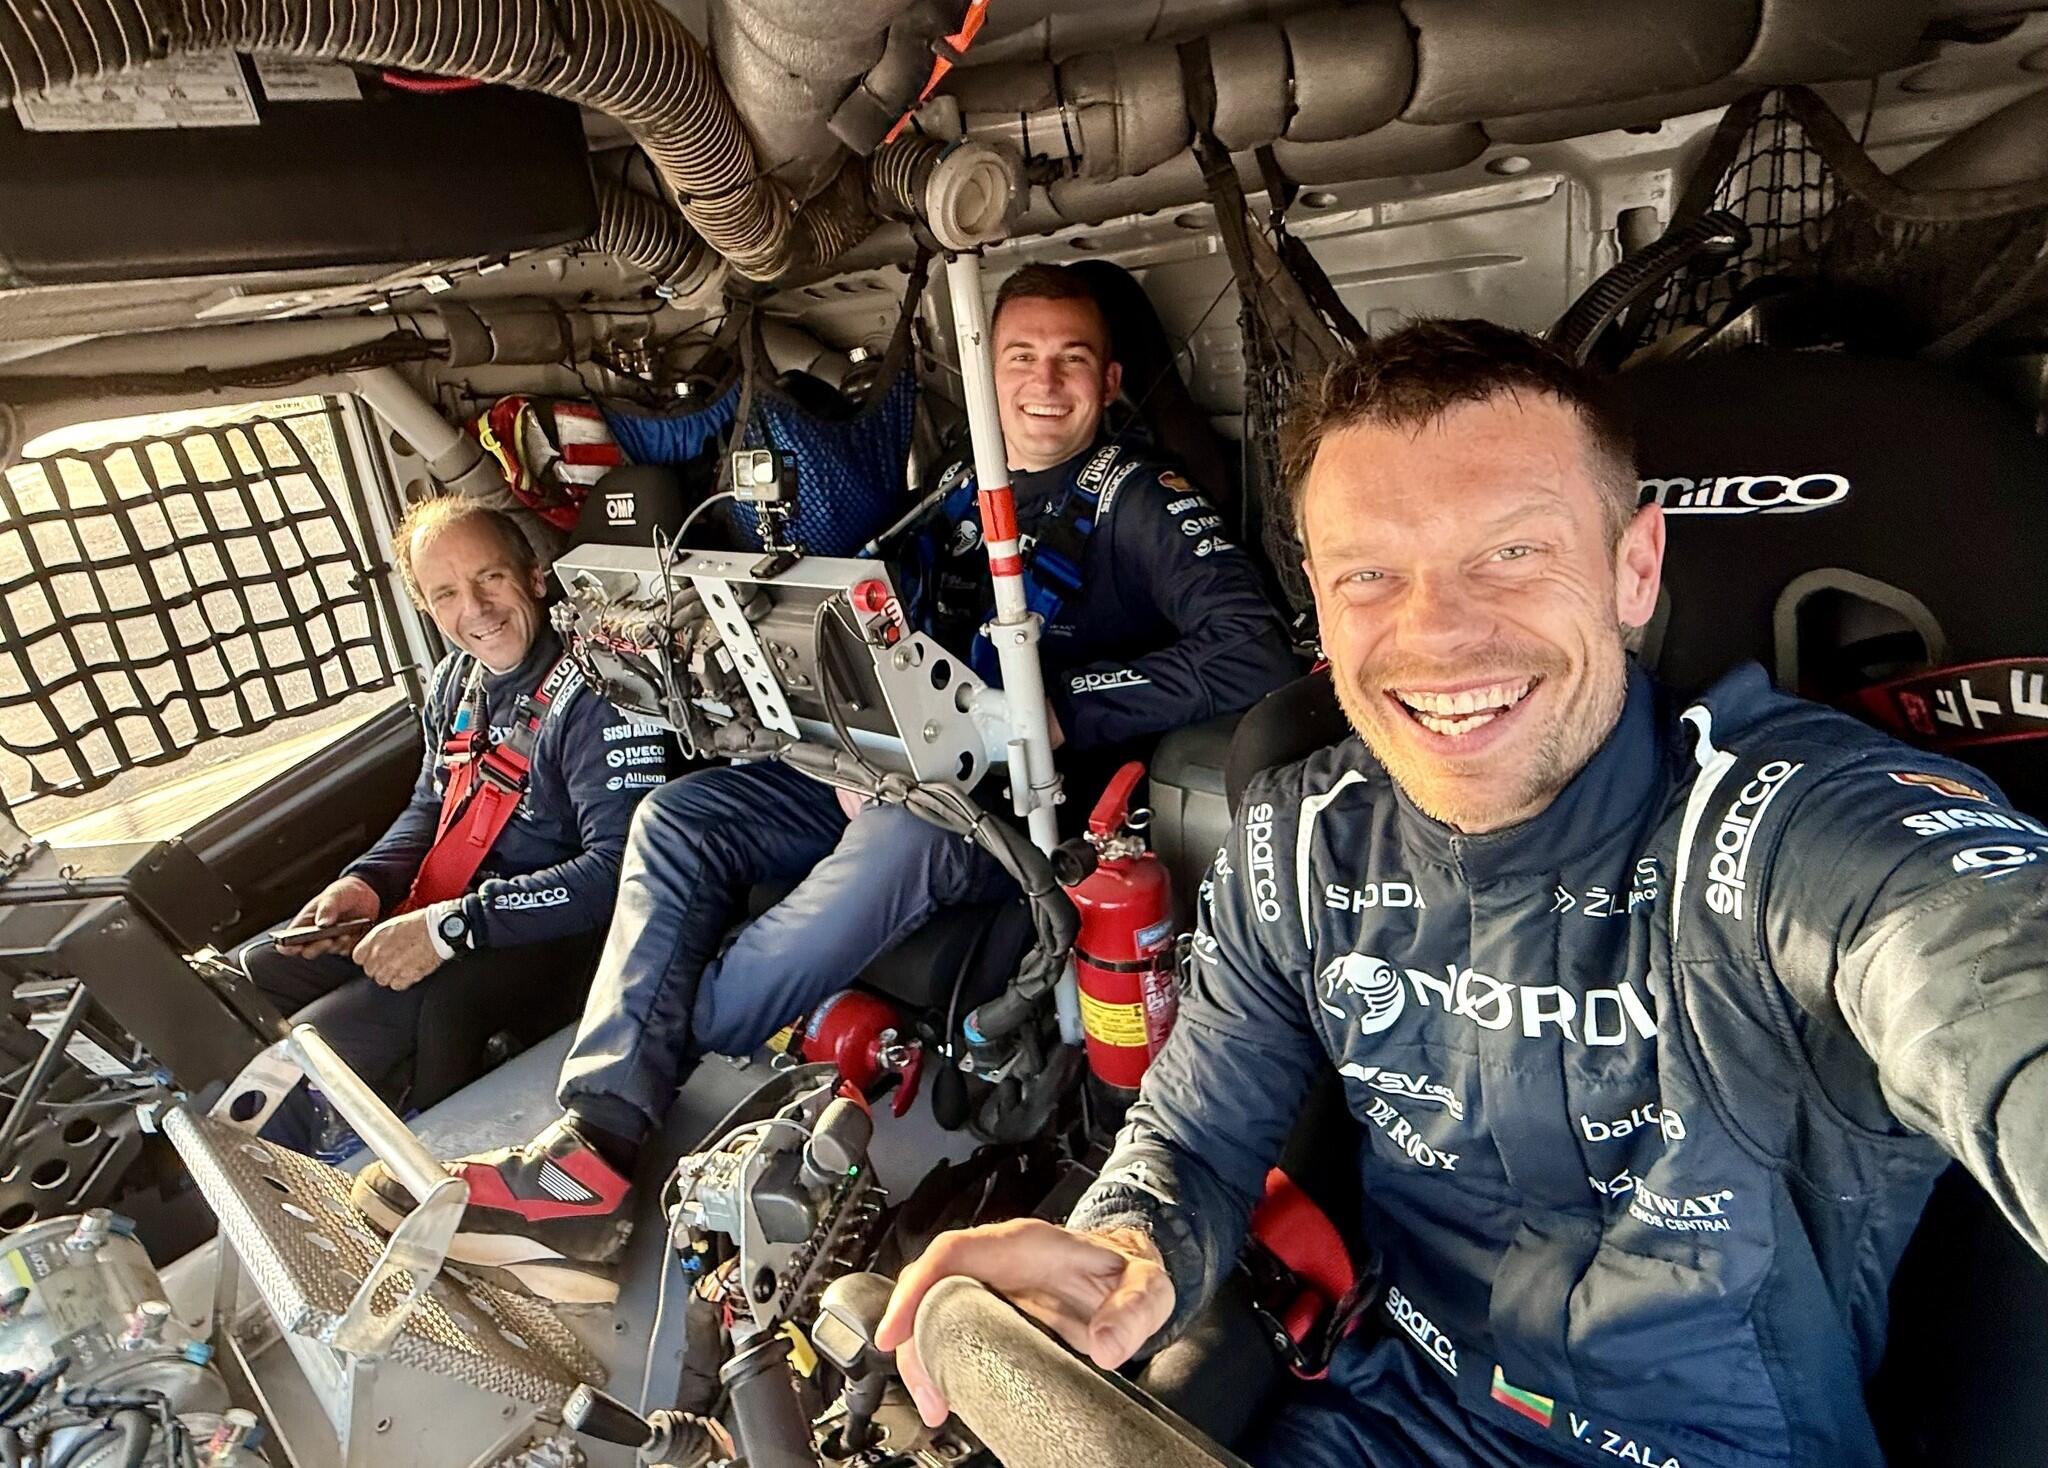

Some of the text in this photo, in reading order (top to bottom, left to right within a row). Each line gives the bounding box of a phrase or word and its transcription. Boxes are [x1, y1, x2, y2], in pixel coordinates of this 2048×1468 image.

[606, 498, 635, 519] OMP
[1070, 669, 1143, 692] sparc
[602, 723, 632, 742] SISU
[625, 744, 665, 758] IVECO
[625, 771, 667, 784] Allison
[1705, 760, 1796, 917] sparco
[1246, 802, 1282, 922] sparco
[494, 887, 568, 910] sparco
[1404, 963, 1657, 1047] NØRDI
[1365, 1096, 1460, 1171] DE ROOY
[1568, 1411, 1592, 1445] V.
